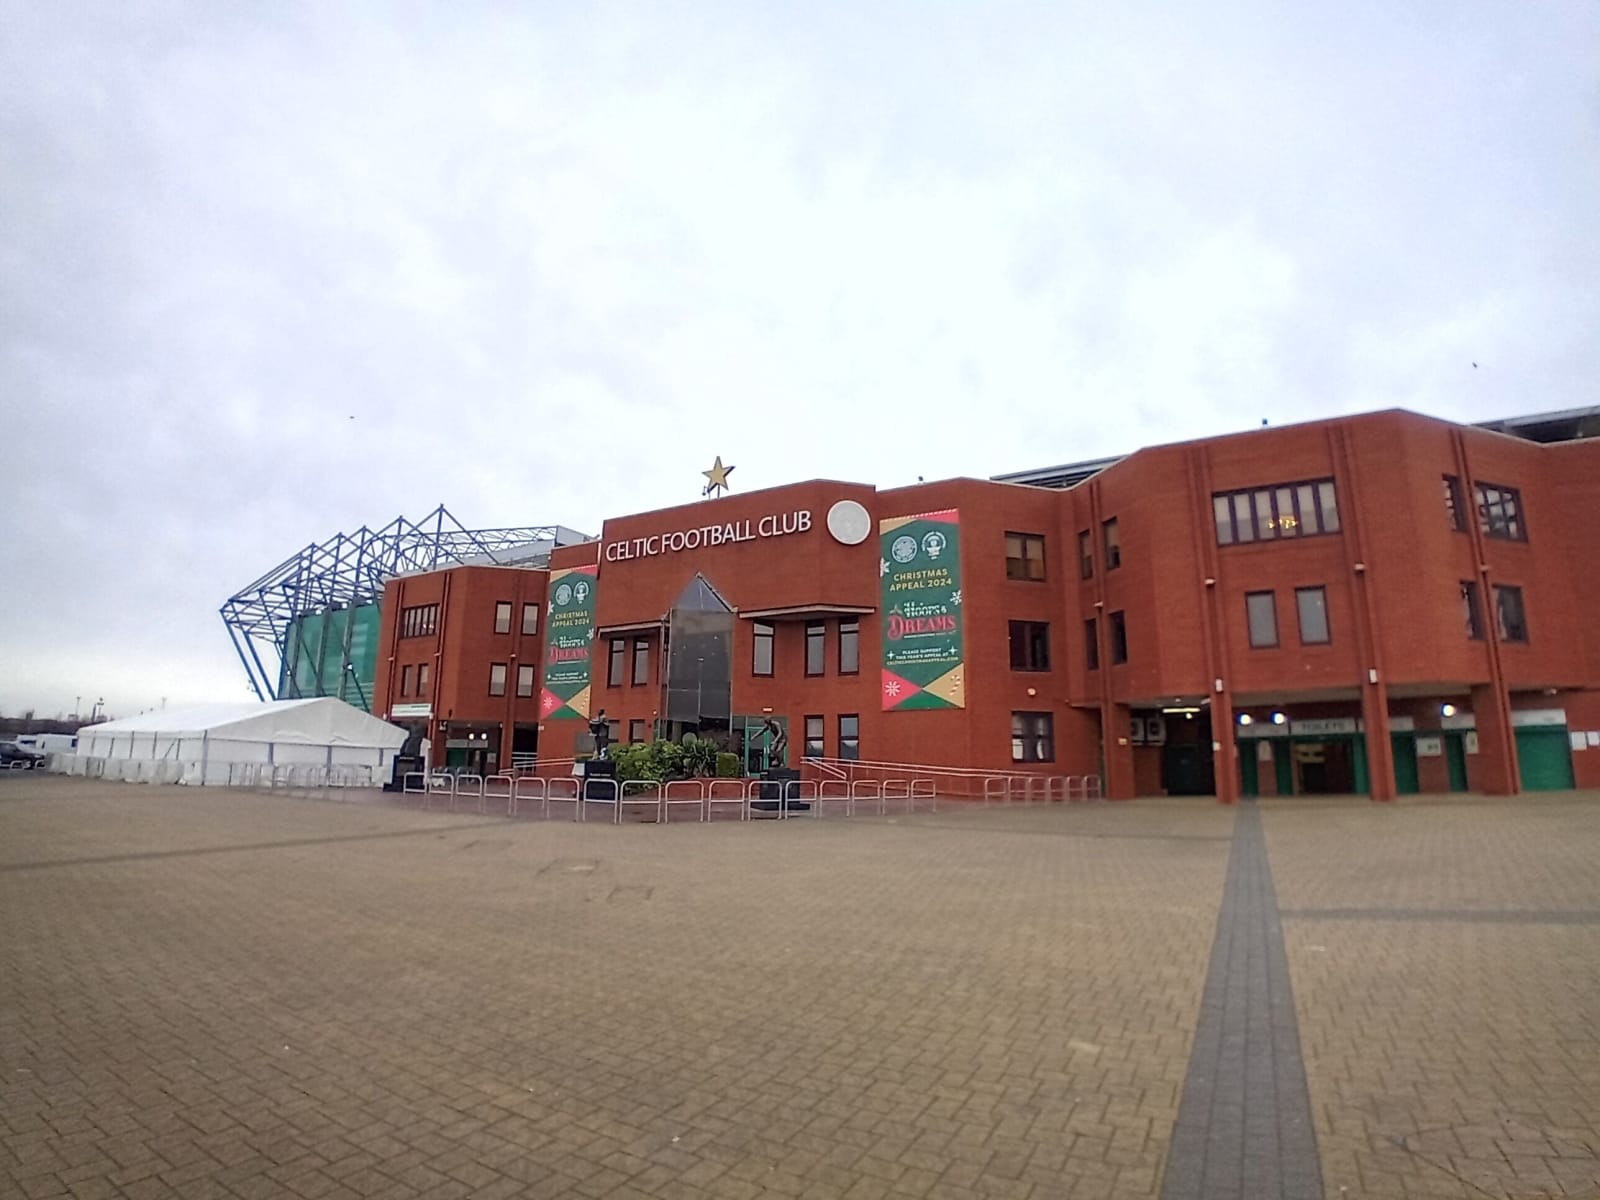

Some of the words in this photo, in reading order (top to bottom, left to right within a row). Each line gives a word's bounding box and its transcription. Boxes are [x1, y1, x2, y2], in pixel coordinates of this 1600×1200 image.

[606, 535, 659, 562] CELTIC
[661, 519, 756, 554] FOOTBALL
[758, 510, 812, 538] CLUB
[893, 568, 948, 582] CHRISTMAS
[889, 580, 925, 592] APPEAL
[927, 577, 953, 588] 2024
[555, 610, 588, 620] CHRISTMAS
[552, 619, 574, 628] APPEAL
[888, 614, 956, 640] DREAMS
